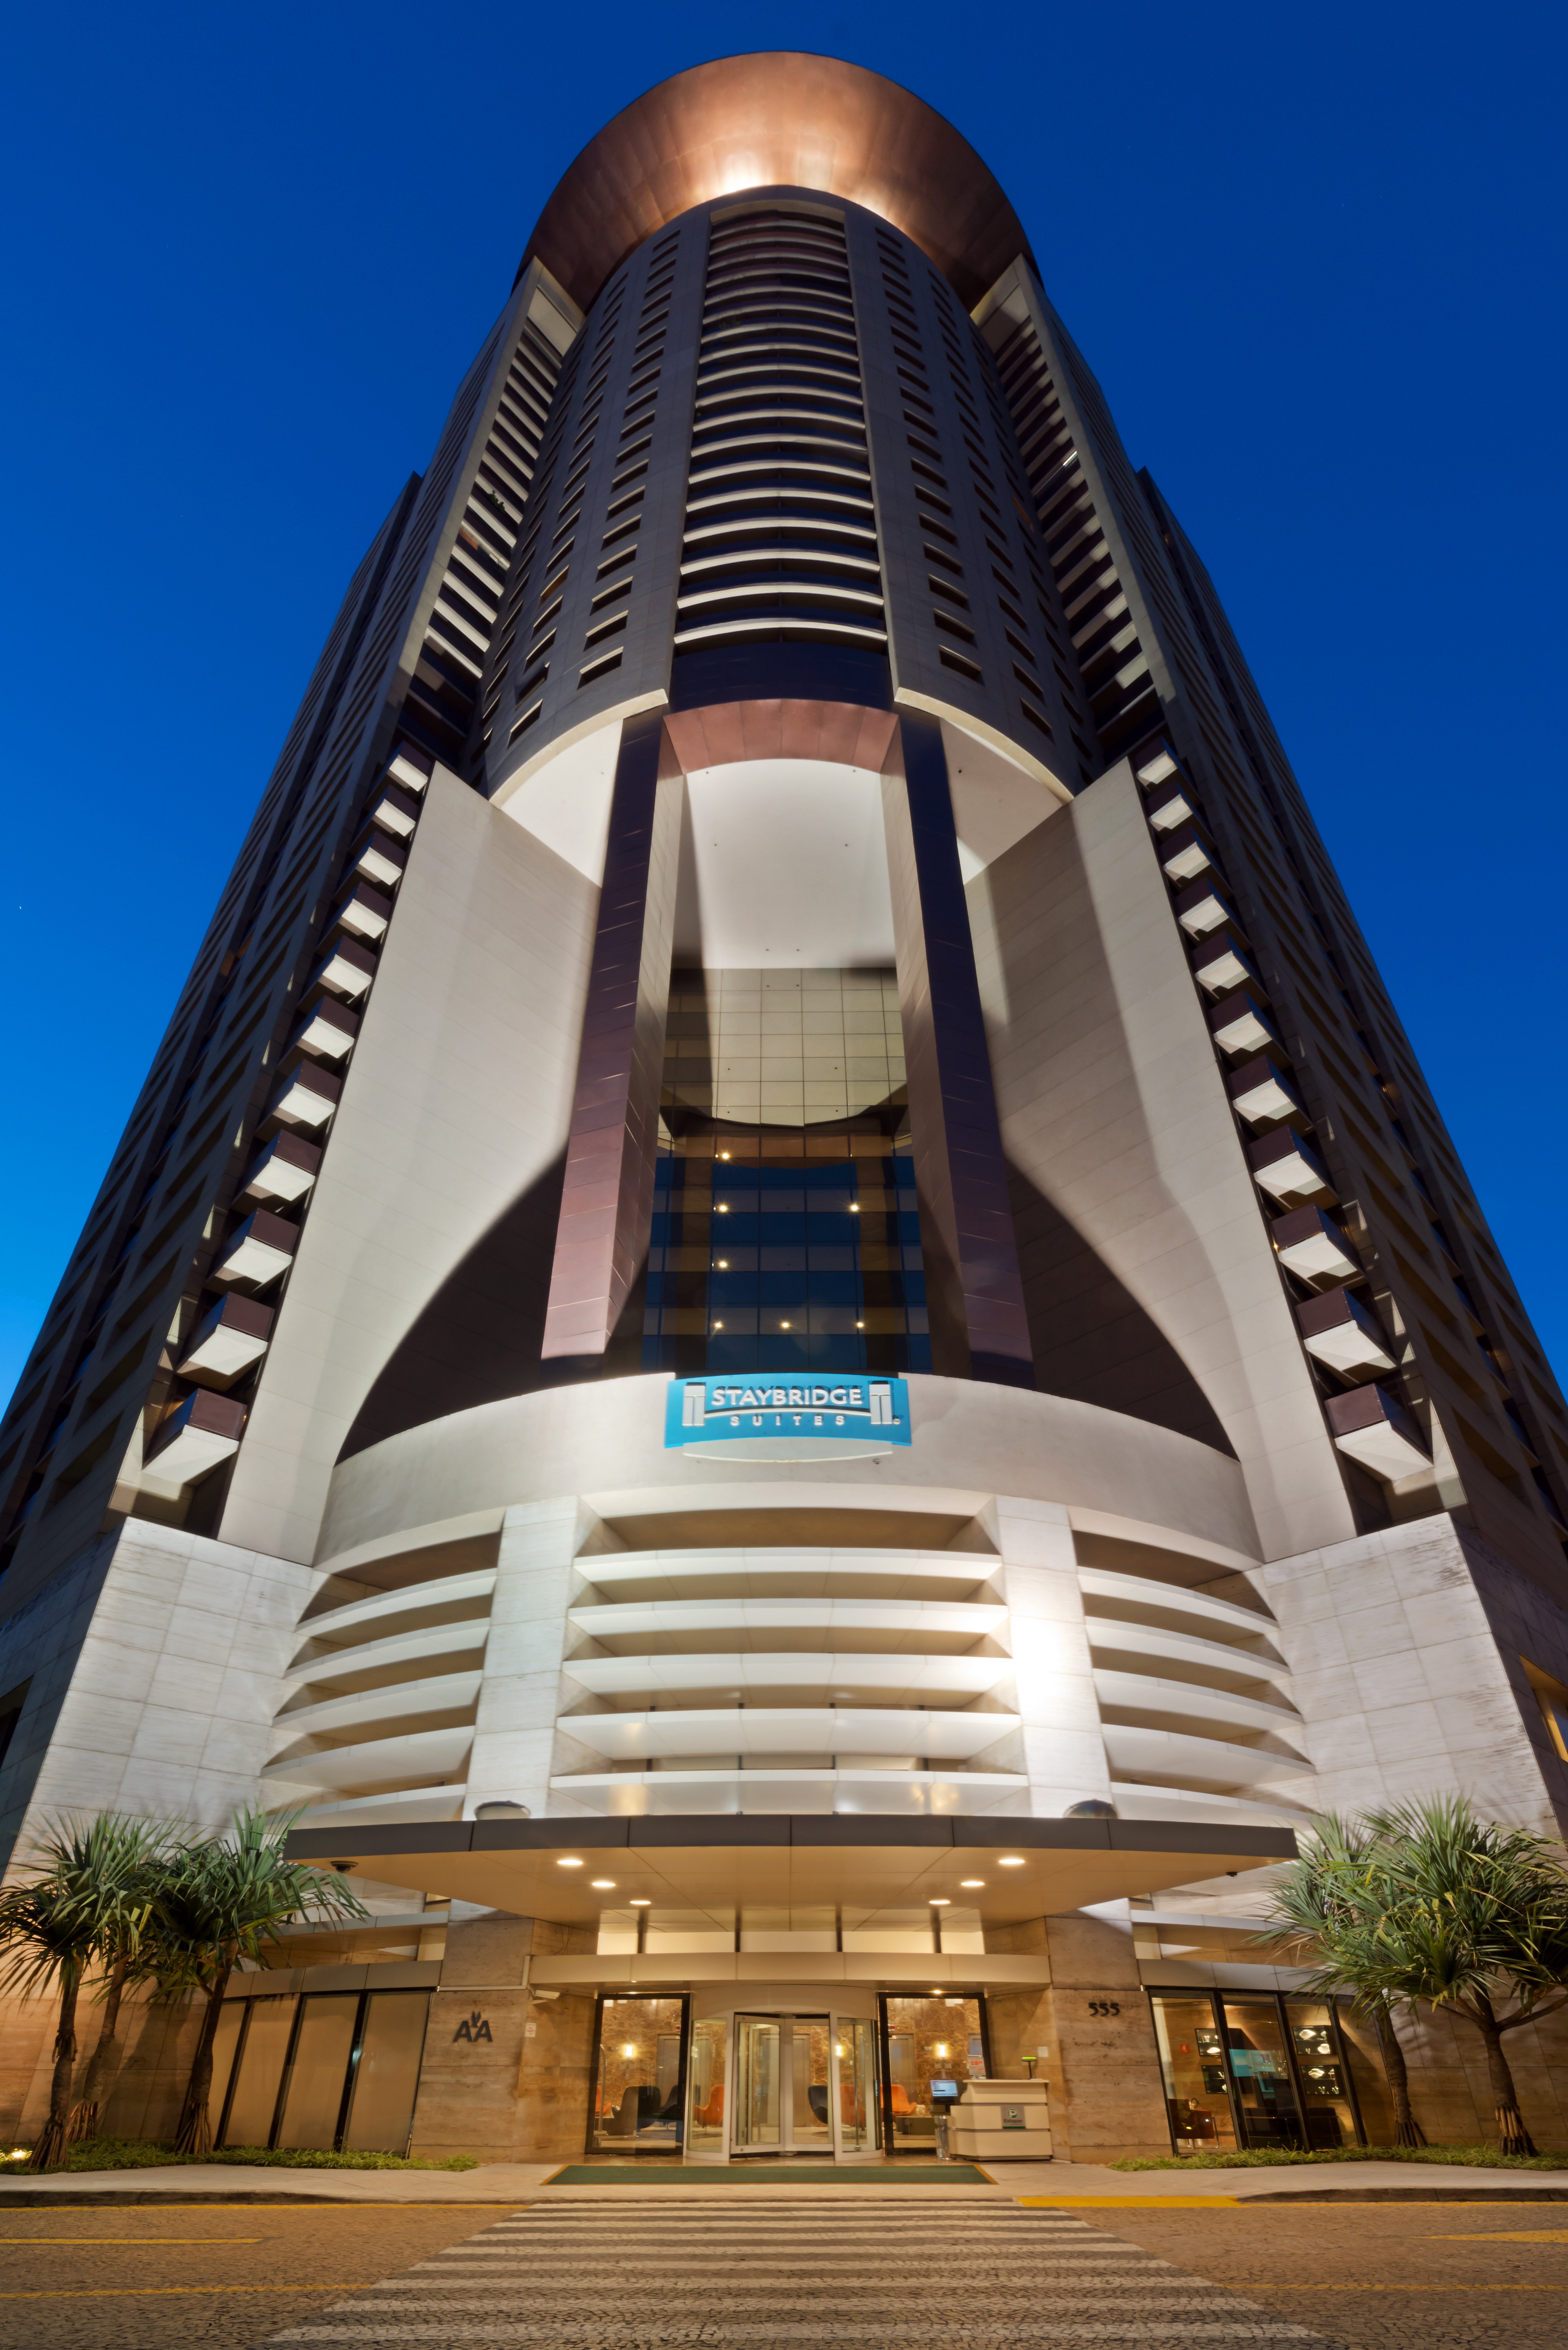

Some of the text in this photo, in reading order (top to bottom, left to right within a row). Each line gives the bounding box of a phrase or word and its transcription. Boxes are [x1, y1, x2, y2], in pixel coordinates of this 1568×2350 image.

[711, 1389, 862, 1405] STAYBRIDGE
[730, 1415, 845, 1426] SUITES
[1088, 2003, 1120, 2016] 555
